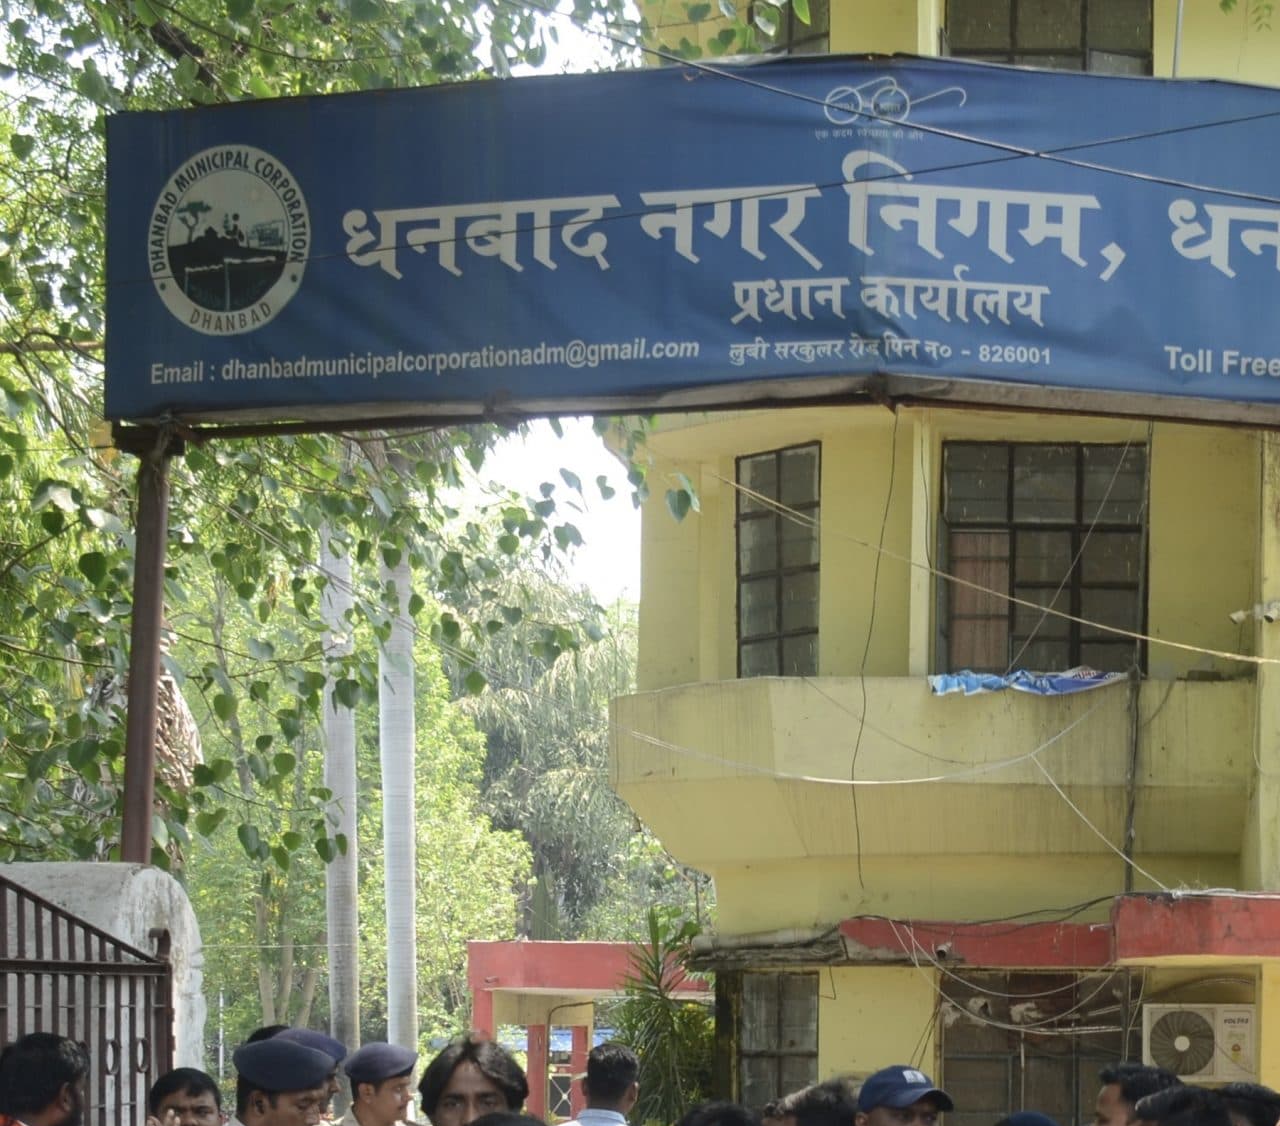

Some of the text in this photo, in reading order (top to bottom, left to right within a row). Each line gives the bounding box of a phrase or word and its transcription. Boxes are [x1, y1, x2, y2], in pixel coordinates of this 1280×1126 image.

[151, 151, 307, 273] DHANBAD MUNICIPAL CORPORATION
[343, 194, 621, 280] धनबाद
[640, 184, 822, 271] नगर
[842, 150, 1127, 281] निगम,
[190, 302, 272, 333] DHANBAD
[730, 264, 1051, 327] प्रधान कार्यालय
[151, 361, 204, 385] Email
[222, 338, 700, 382] dhanbadmunicipalcorporationadm@gmail.com
[775, 339, 845, 363] सरकुलर
[849, 335, 880, 360] रोड
[880, 331, 921, 360] पिन
[979, 345, 1052, 365] 826001
[1164, 345, 1212, 373] Toll
